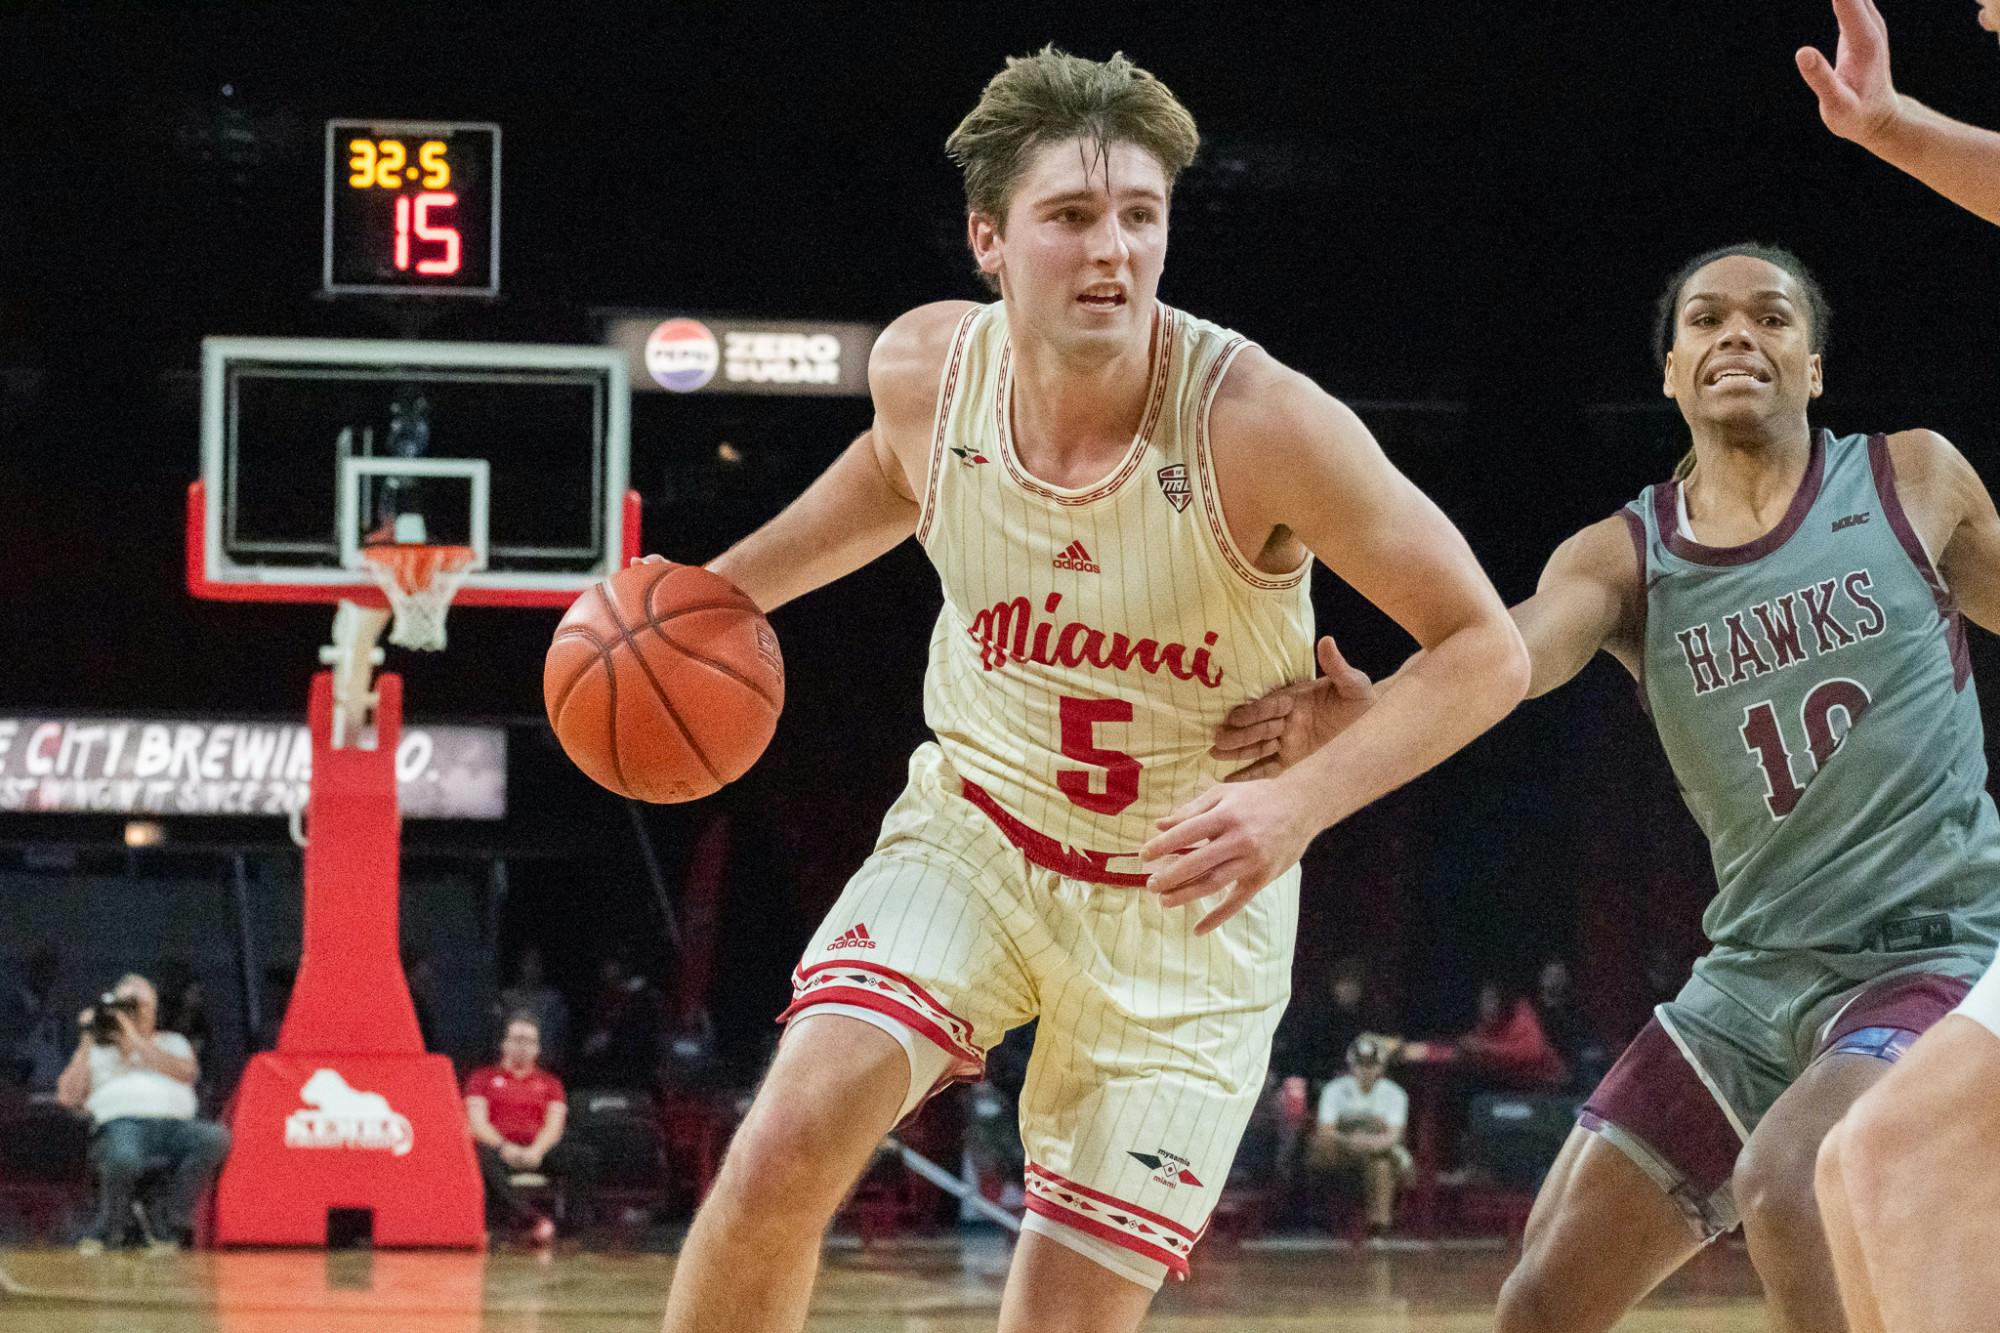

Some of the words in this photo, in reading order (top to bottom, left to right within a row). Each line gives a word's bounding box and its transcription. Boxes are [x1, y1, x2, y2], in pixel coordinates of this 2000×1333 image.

[350, 139, 450, 189] 32.5
[394, 192, 462, 275] 15
[1053, 558, 1100, 574] adidas
[967, 592, 1223, 688] Miami
[1675, 568, 1886, 696] HAWKS
[1057, 695, 1144, 816] 5
[1738, 677, 1872, 822] 10
[827, 938, 876, 951] adidas
